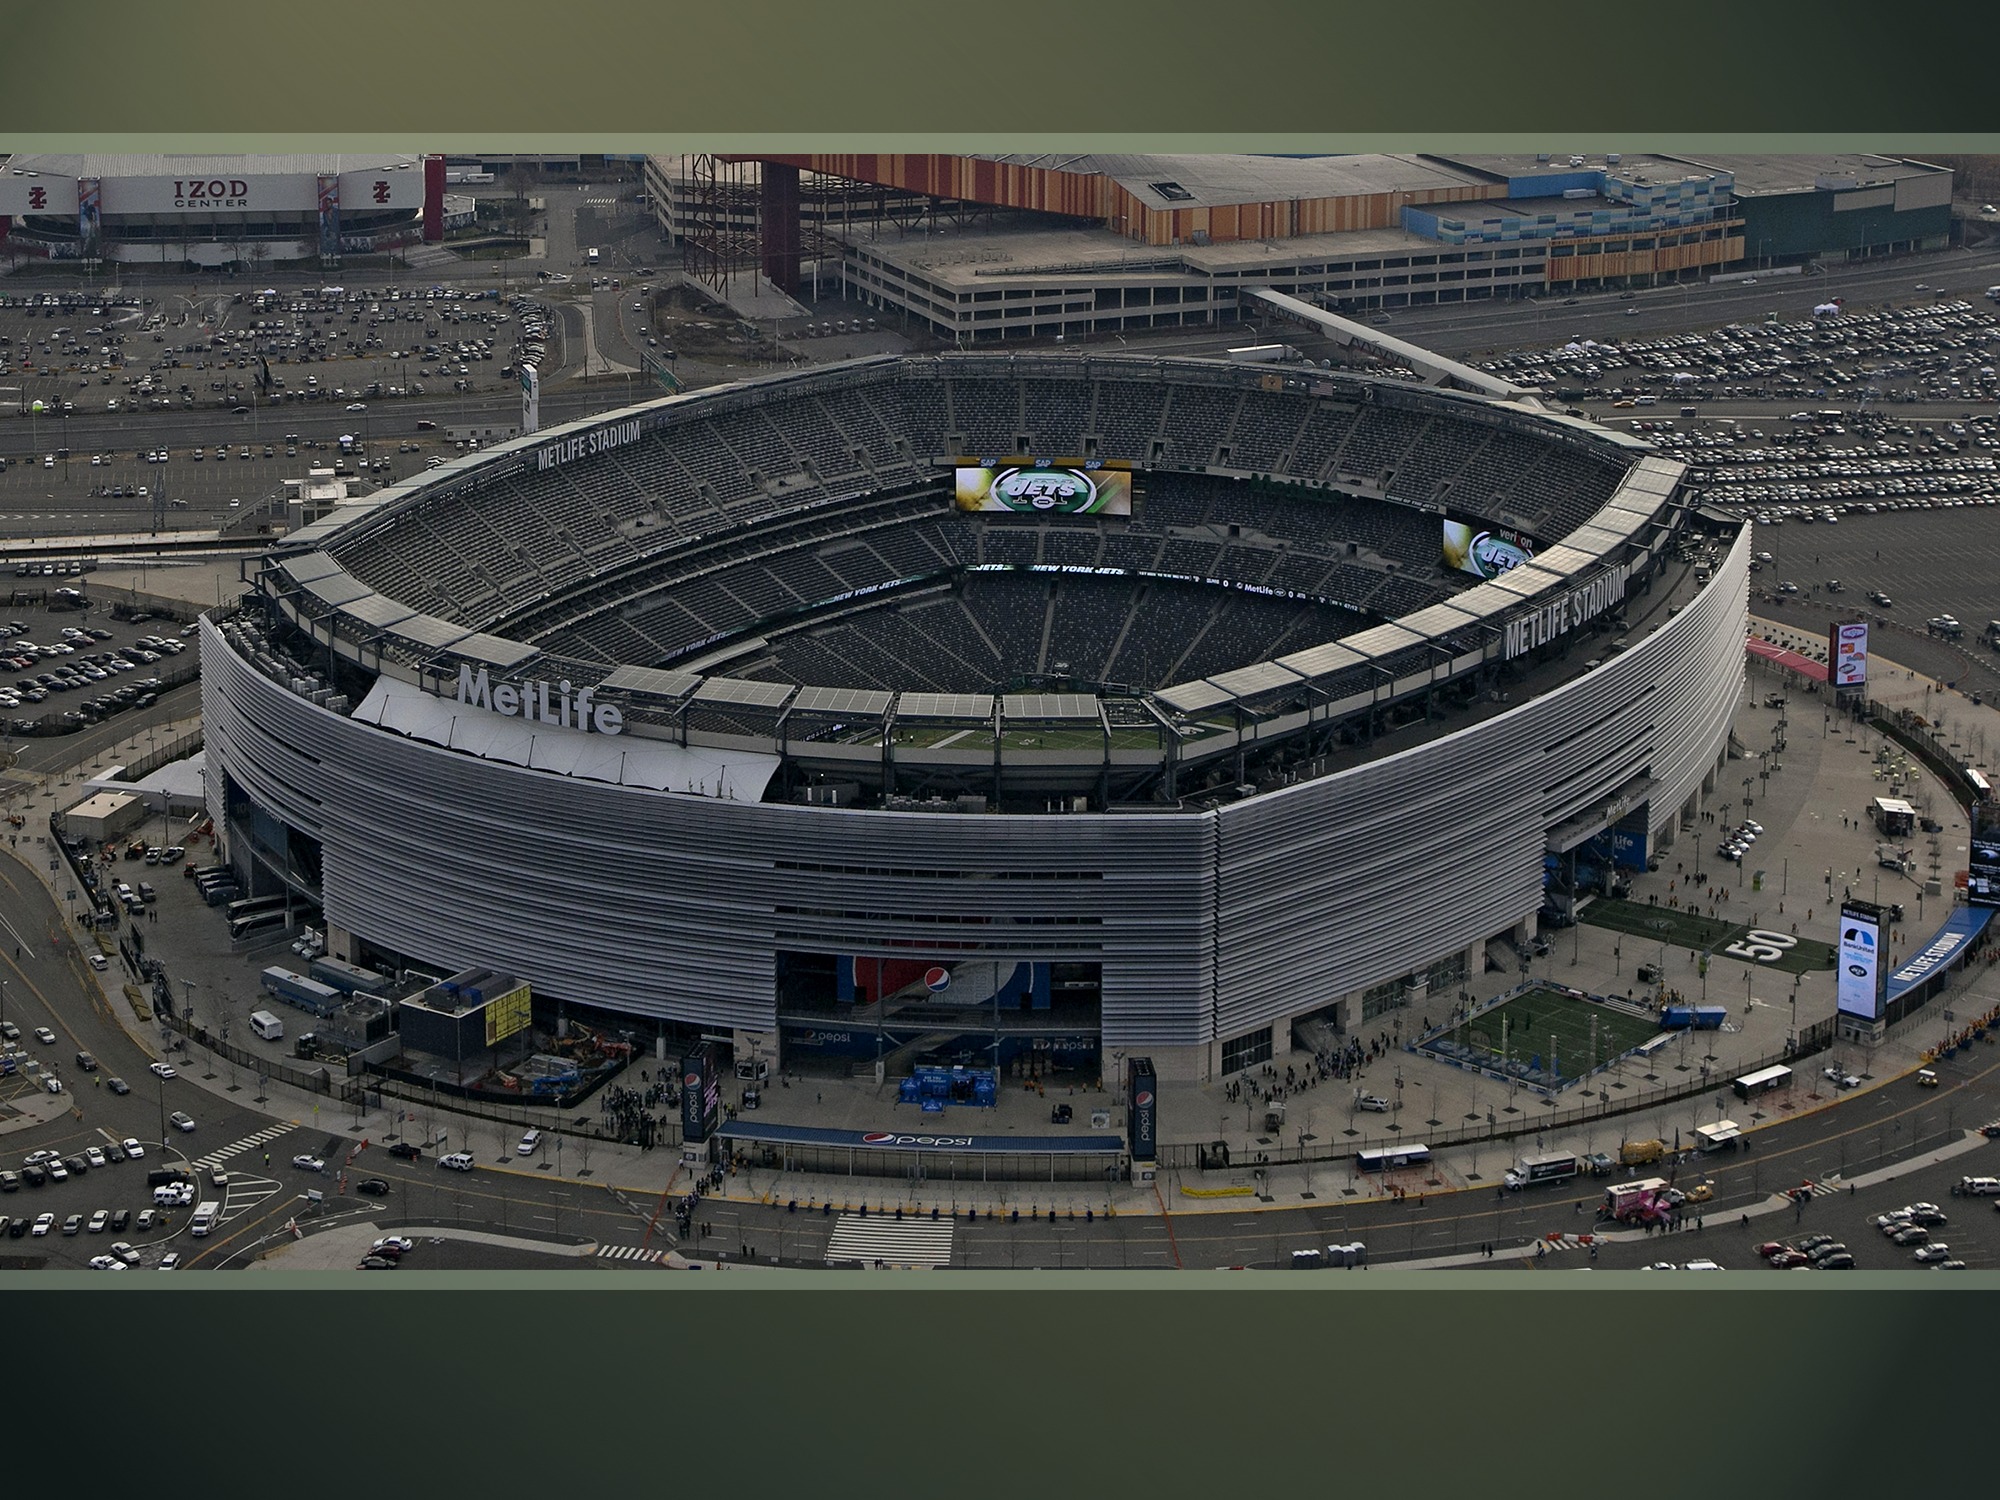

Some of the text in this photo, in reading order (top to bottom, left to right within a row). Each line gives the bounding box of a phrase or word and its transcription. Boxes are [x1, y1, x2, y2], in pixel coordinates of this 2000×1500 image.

[174, 180, 248, 198] IZOD
[174, 199, 248, 208] CENTER
[537, 420, 641, 471] METLIFE STADIUM
[980, 459, 997, 467] SAP
[1035, 459, 1052, 468] SAP
[1085, 461, 1102, 469] SAP
[1008, 480, 1077, 497] JETS
[1032, 564, 1125, 575] NEW YORK JETS
[834, 579, 902, 602] NEW YORK JETS
[1244, 583, 1274, 596] MetLife
[1505, 565, 1627, 660] METLIFE STADIUM
[457, 663, 624, 735] MetLife
[1725, 929, 1798, 962] 50
[1843, 941, 1875, 954] BankUnited
[1893, 955, 1940, 982] METLIFE
[1925, 932, 1965, 957] STADIUM
[818, 1032, 851, 1043] pepsi
[688, 1091, 699, 1123] pepsi
[1140, 1110, 1151, 1141] pepsi
[896, 1135, 973, 1147] pepsi
